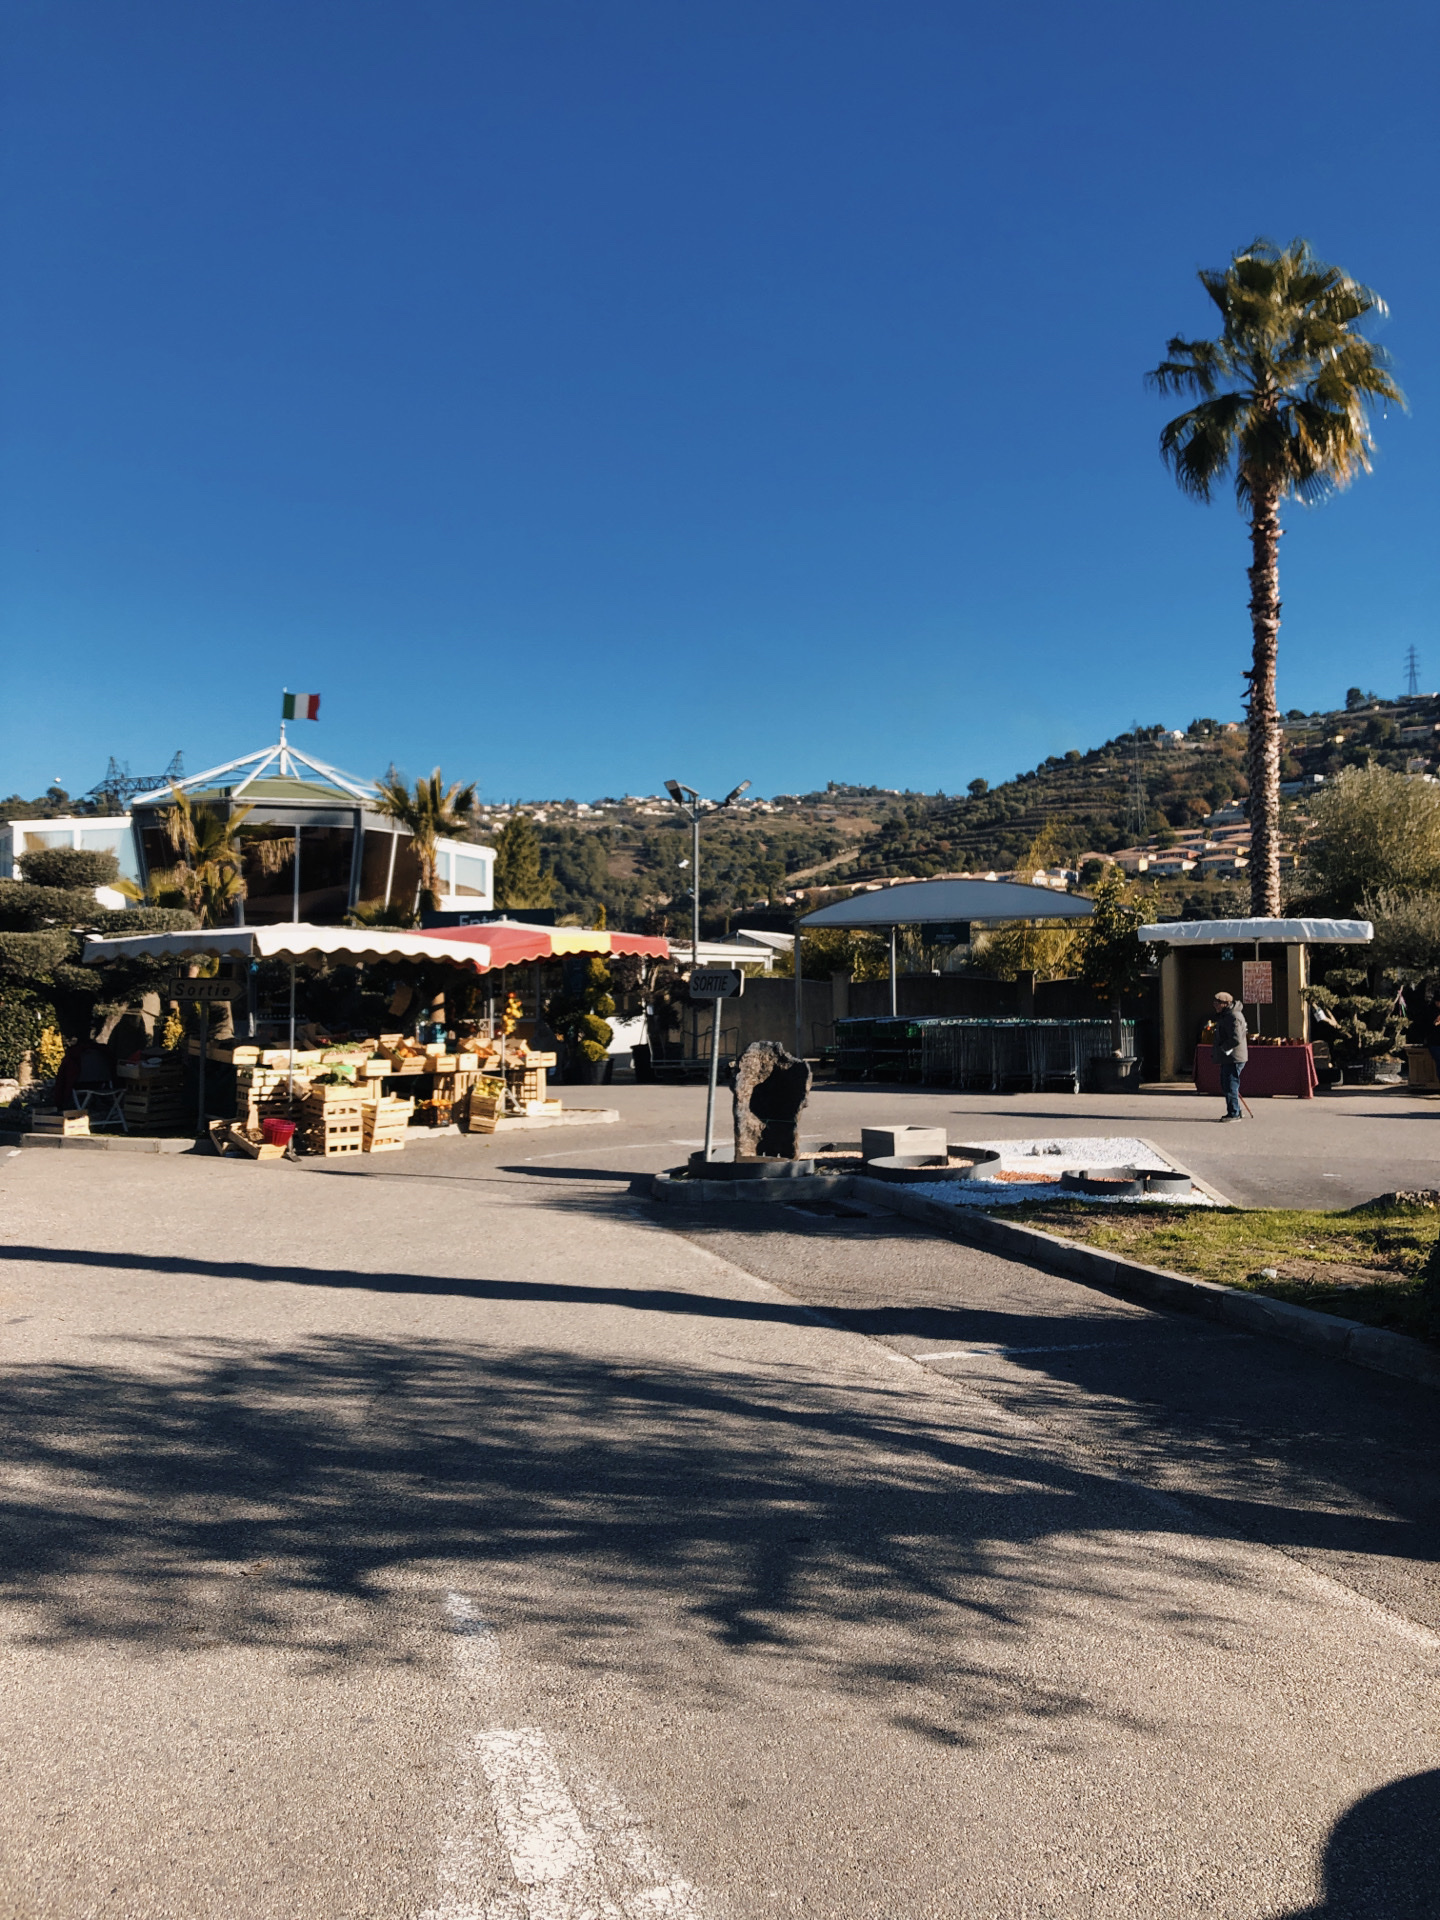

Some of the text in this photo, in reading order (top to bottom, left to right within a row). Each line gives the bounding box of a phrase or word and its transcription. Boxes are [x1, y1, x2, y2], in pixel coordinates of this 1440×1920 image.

[459, 914, 518, 926] Ent
[174, 982, 231, 997] Sortie
[692, 975, 729, 992] SORTIE
